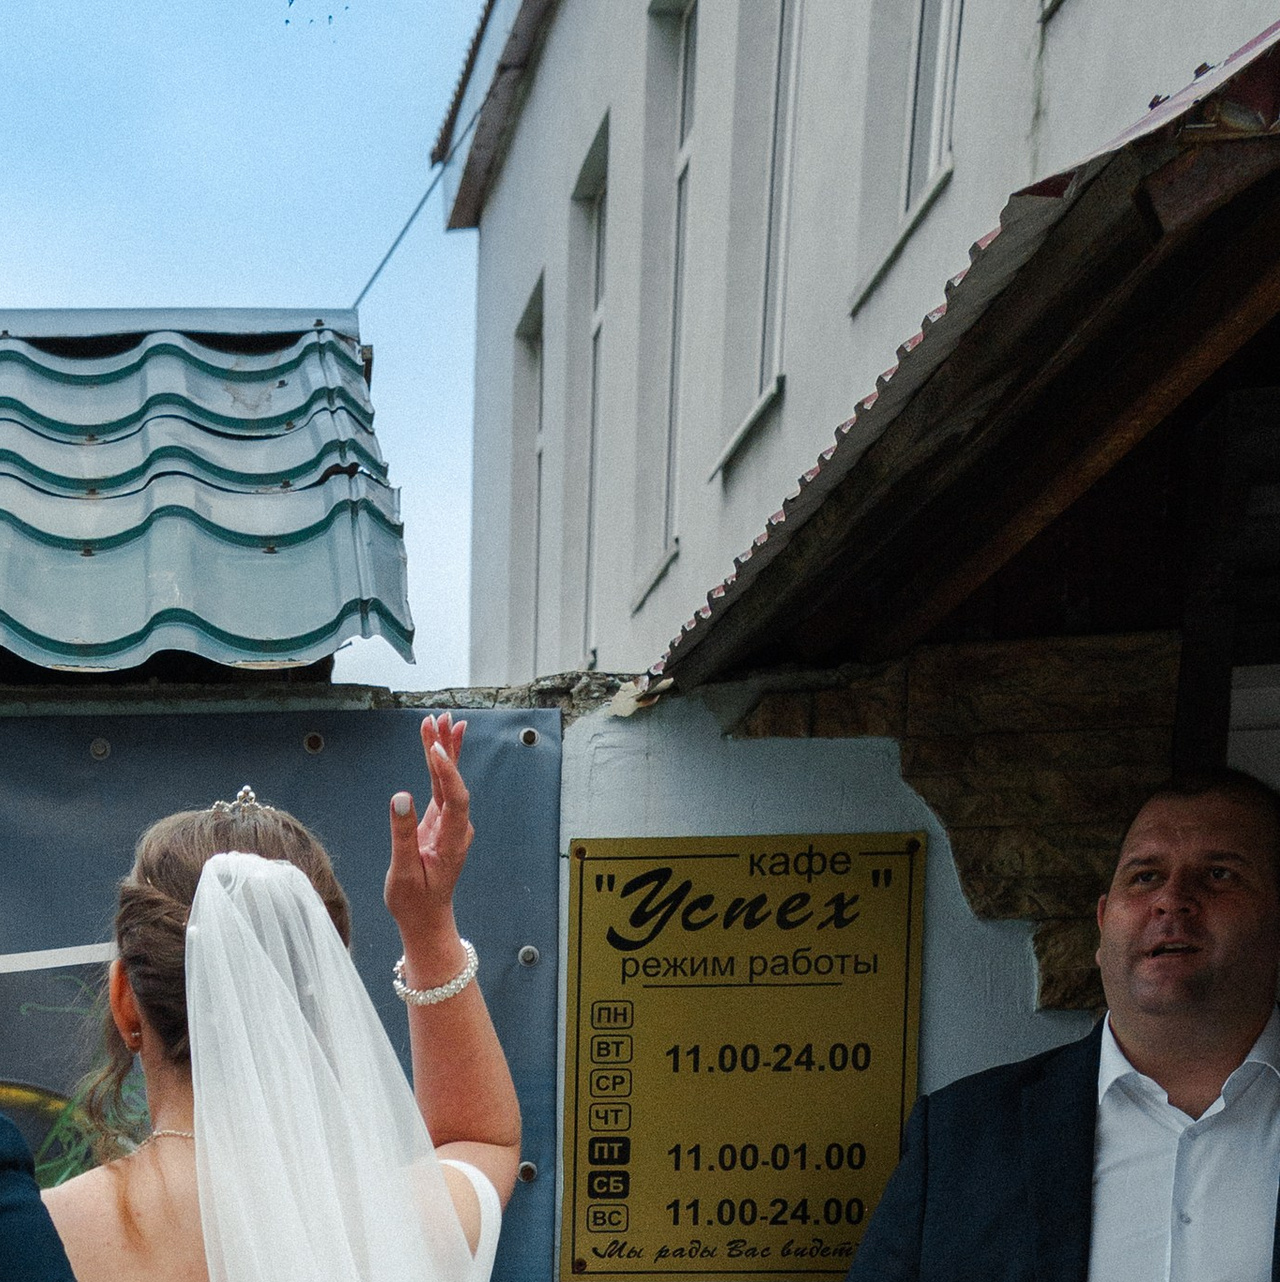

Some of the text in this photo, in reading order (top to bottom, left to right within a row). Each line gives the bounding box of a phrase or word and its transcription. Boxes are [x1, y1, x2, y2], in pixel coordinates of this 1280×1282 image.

[749, 844, 852, 883] кафе
[621, 946, 879, 985] режим работы
[596, 1006, 628, 1024] ПН
[596, 1041, 625, 1058] ВТ
[665, 1042, 871, 1073] 11.00-24.00
[595, 1074, 626, 1092] СР
[594, 1108, 624, 1126] ЧТ
[593, 1142, 624, 1160] ПТ
[667, 1142, 867, 1172] 11.00-01.00
[592, 1176, 624, 1194] СБ
[591, 1209, 623, 1227] ВС
[665, 1197, 865, 1226] 11.00-24.00
[592, 1238, 861, 1264] Мы рады Вас видет
